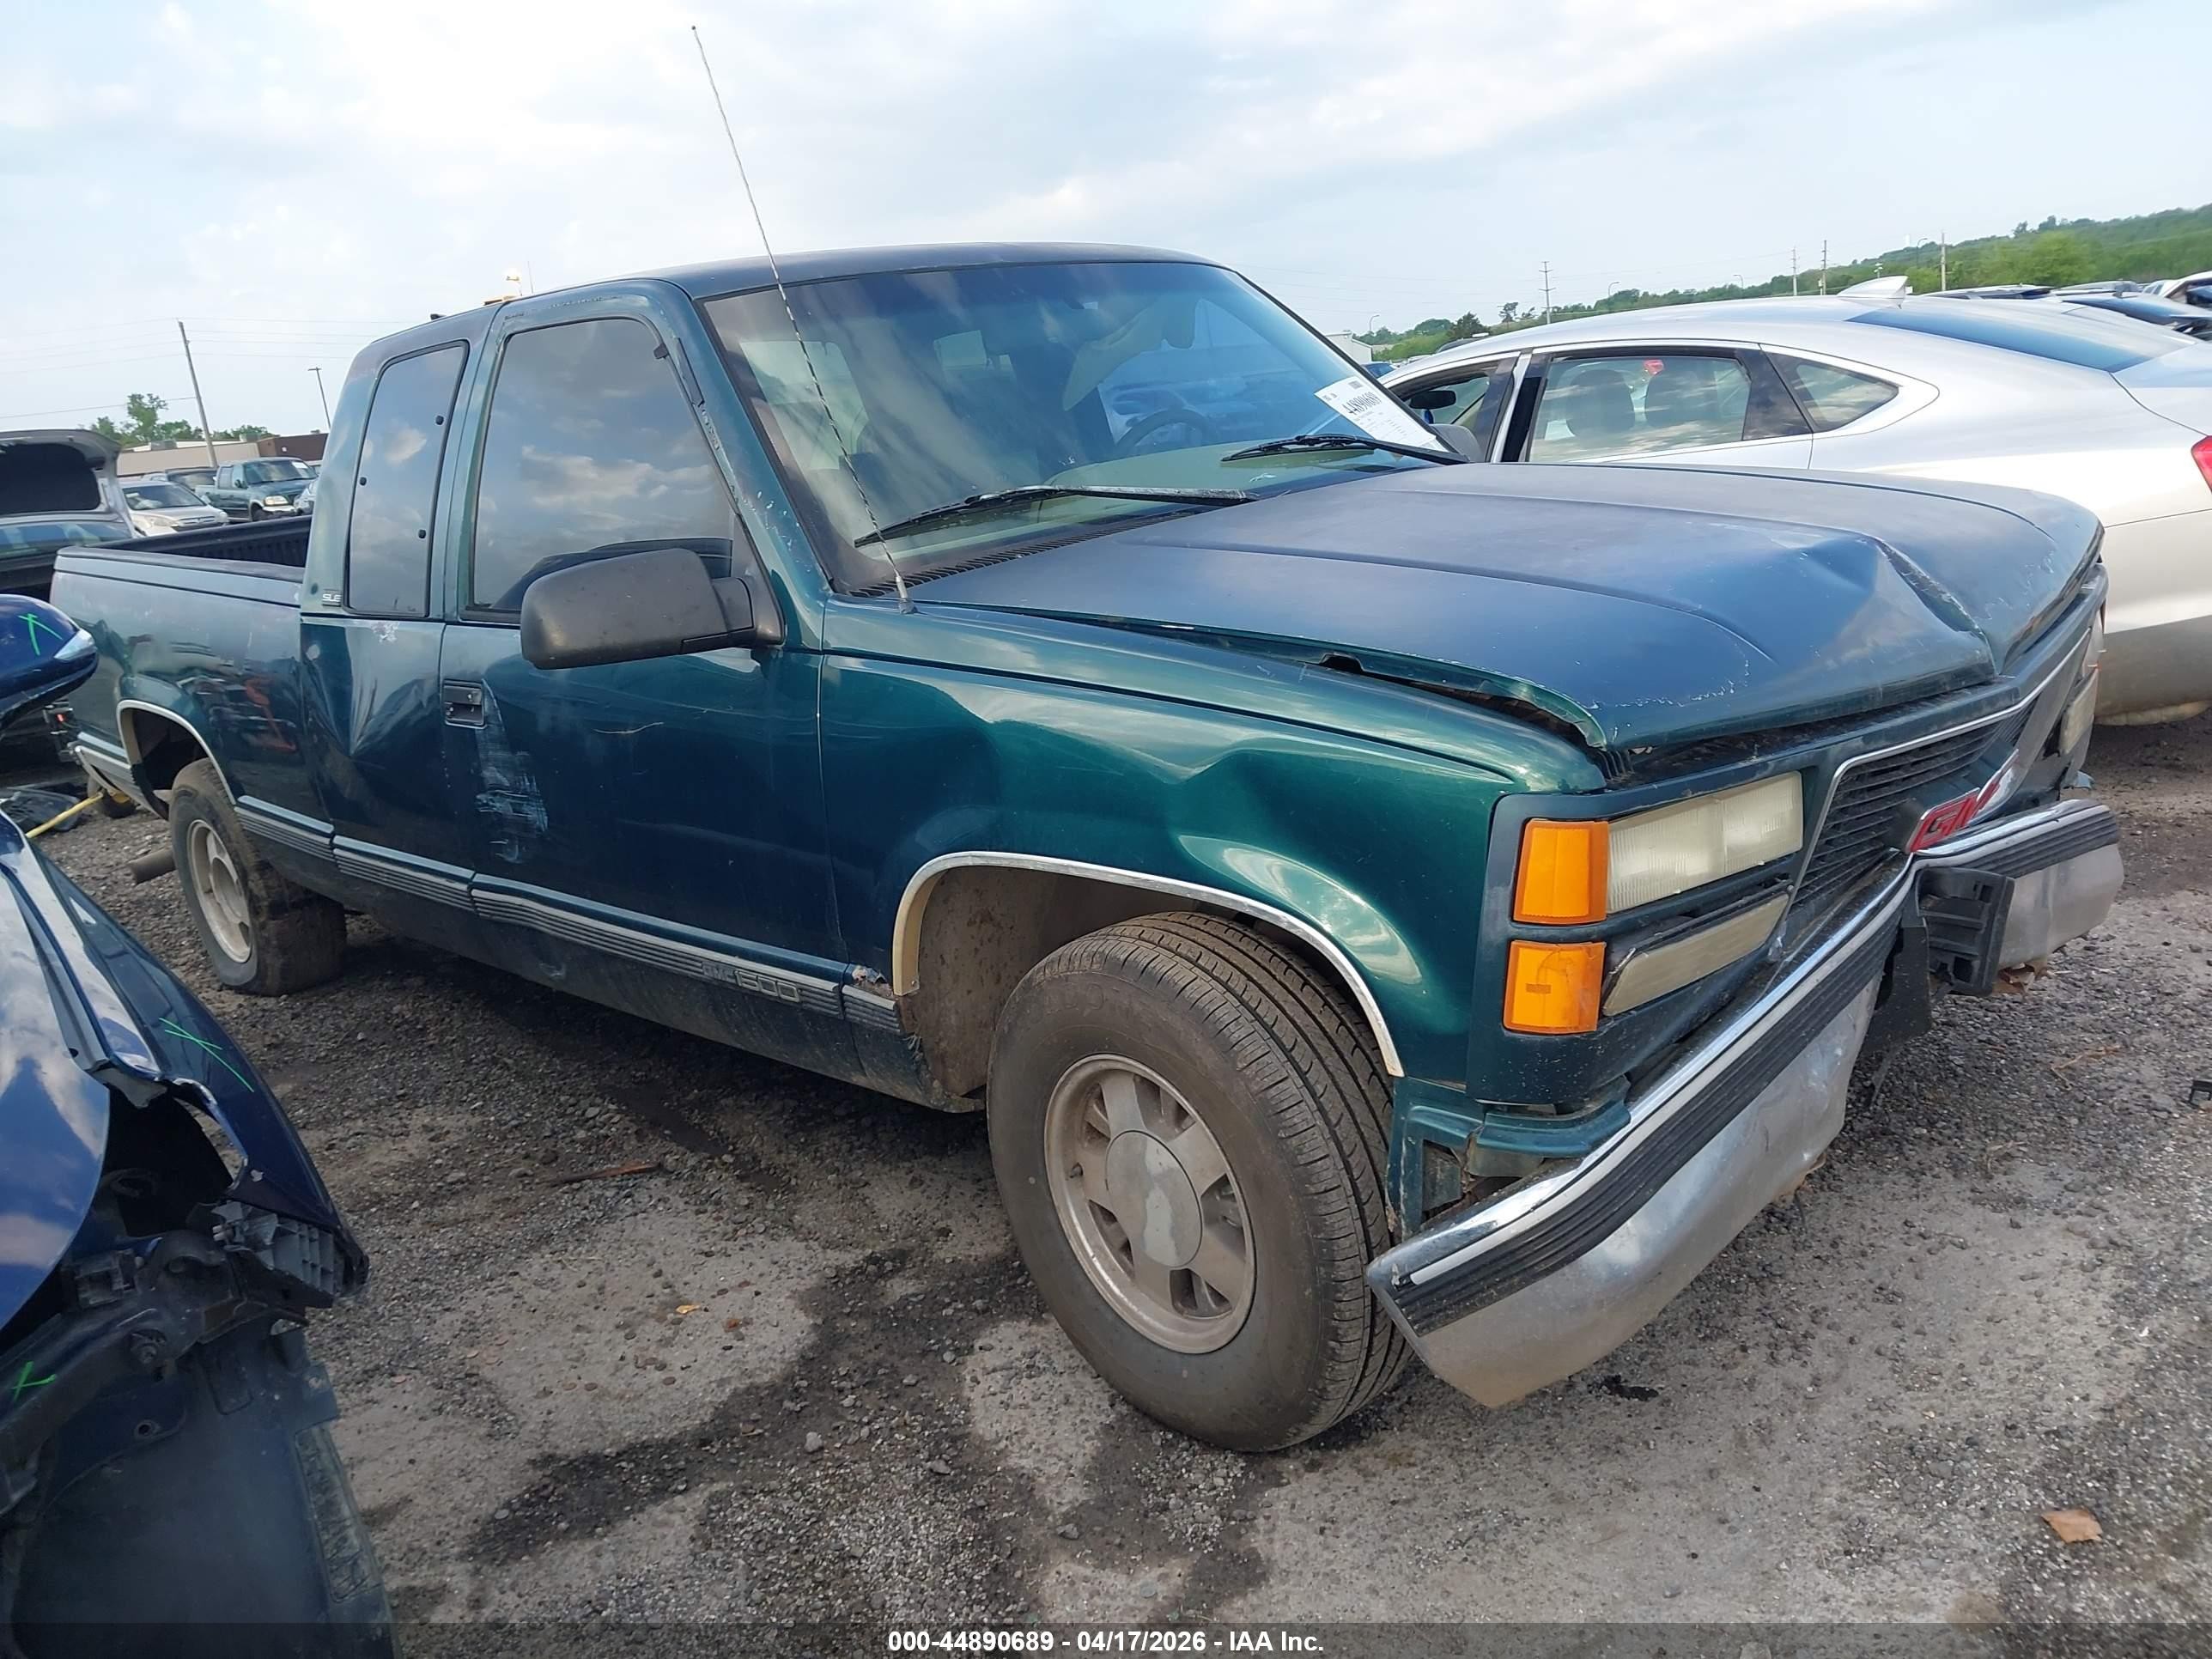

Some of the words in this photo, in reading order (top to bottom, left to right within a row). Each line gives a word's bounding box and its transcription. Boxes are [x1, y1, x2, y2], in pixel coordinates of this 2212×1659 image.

[1341, 392, 1382, 416] 44890689
[322, 593, 342, 603] SLE
[734, 969, 799, 1003] 1500
